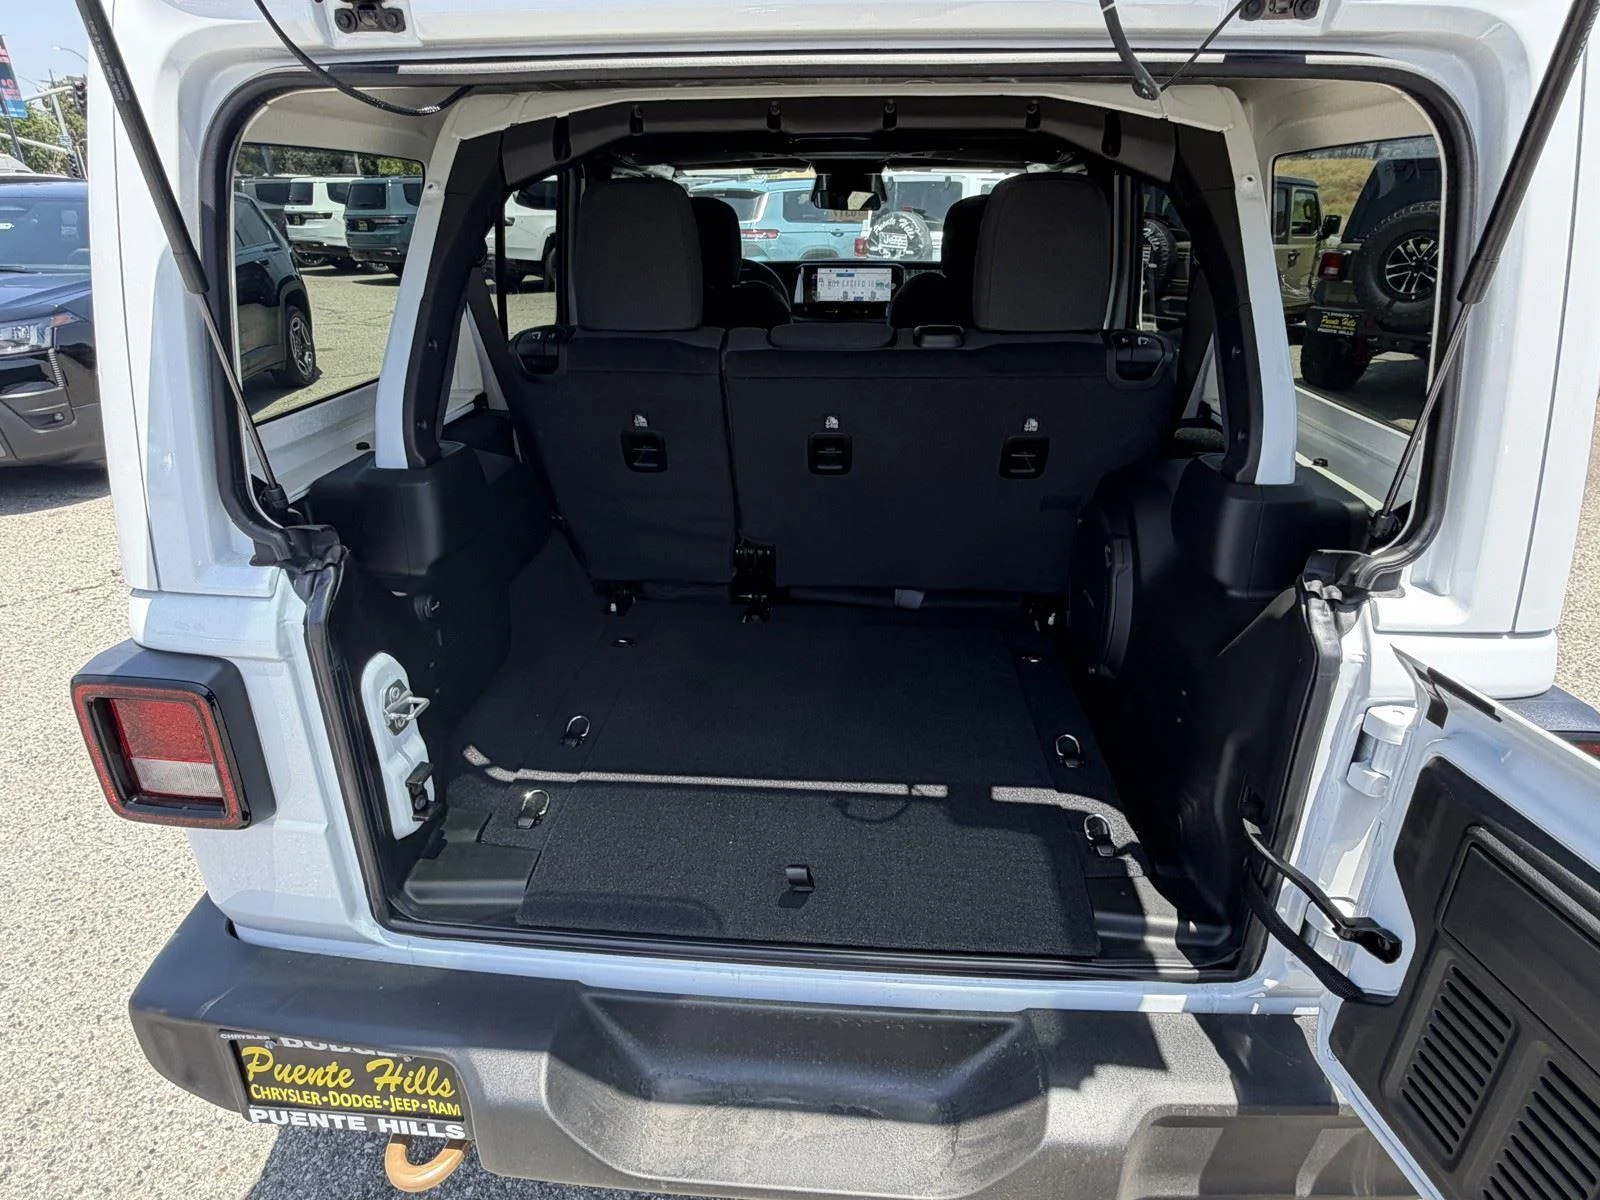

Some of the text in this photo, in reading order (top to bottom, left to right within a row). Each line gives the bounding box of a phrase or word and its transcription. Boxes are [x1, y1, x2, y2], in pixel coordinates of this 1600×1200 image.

[241, 1046, 456, 1098] Puente Hills
[249, 1109, 466, 1139] PUENTE HILLS
